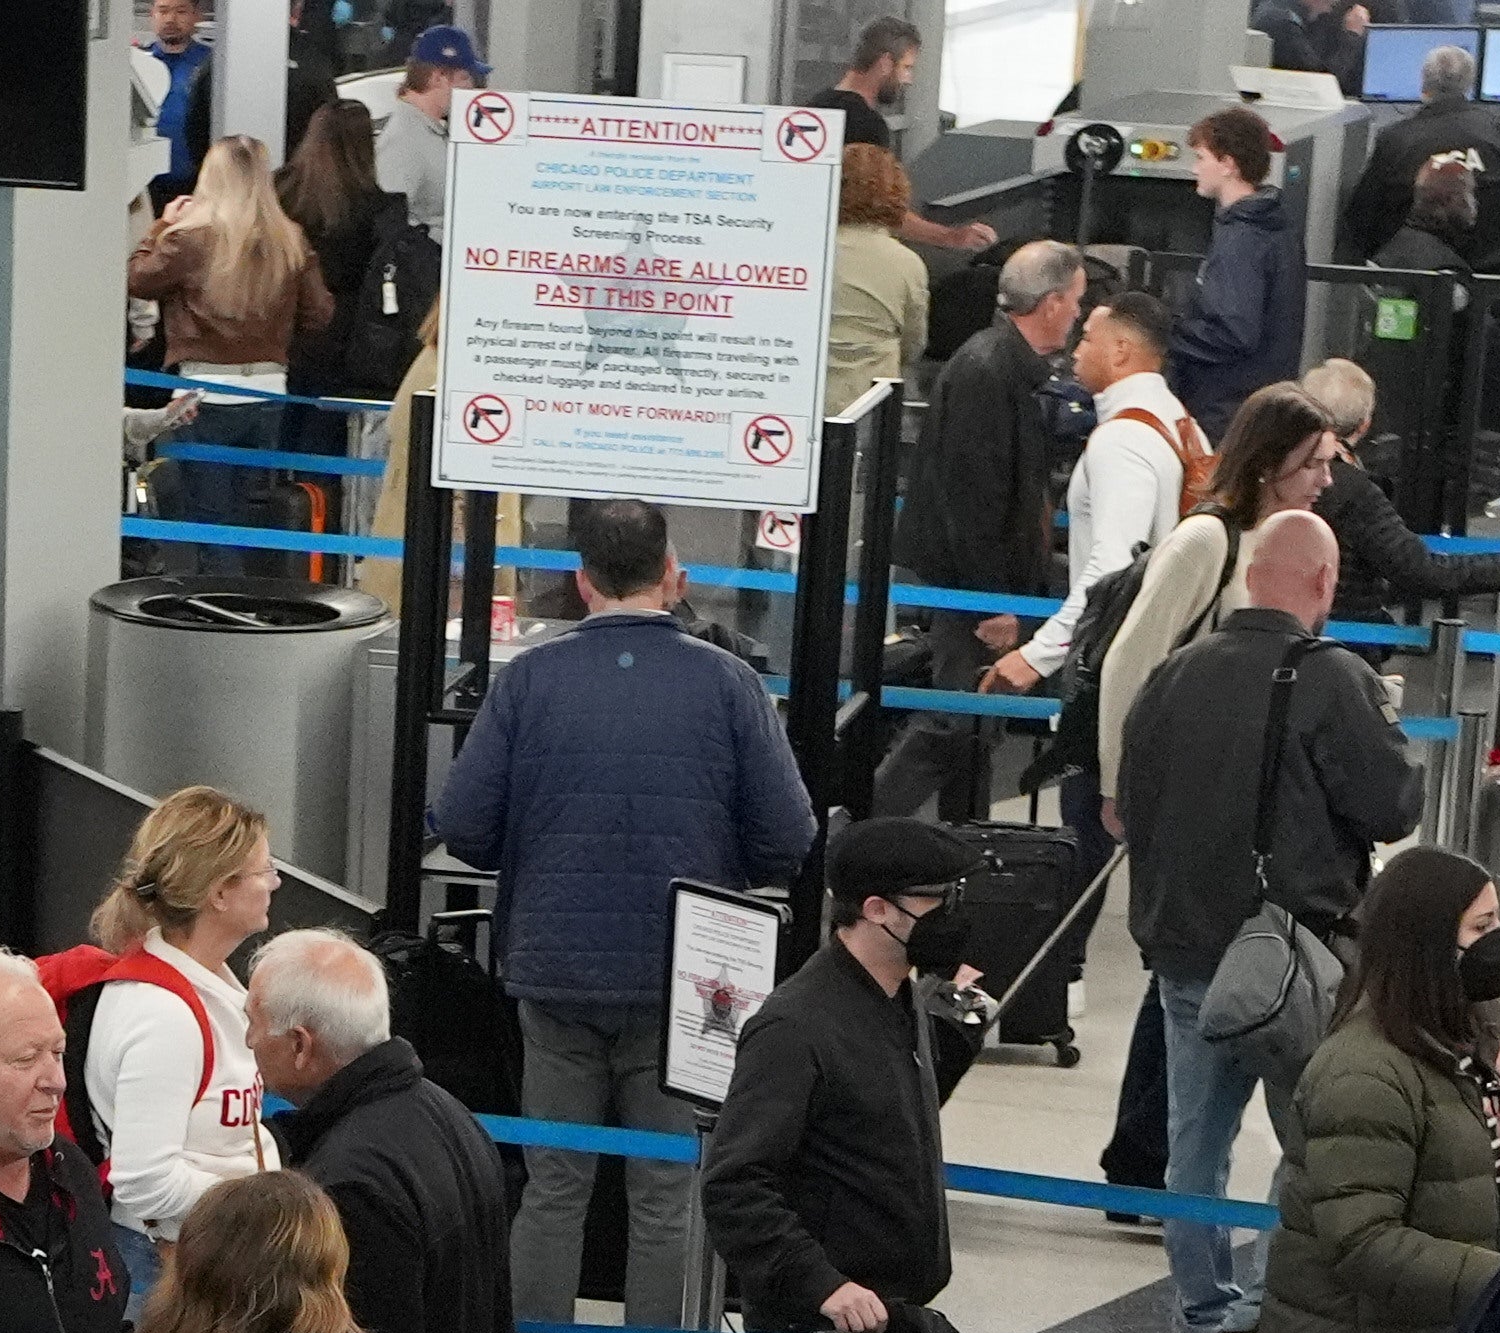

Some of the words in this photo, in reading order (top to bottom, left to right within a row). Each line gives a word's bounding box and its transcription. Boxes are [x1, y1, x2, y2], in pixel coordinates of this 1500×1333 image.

[535, 162, 599, 177] CHICAGO
[603, 165, 653, 180] POLICE
[658, 168, 754, 186] DEPARTMENT
[507, 203, 534, 216] You
[538, 207, 559, 217] are
[563, 208, 592, 219] now
[597, 208, 653, 224] entering
[657, 211, 679, 224] the
[683, 212, 712, 225] TSA
[716, 214, 774, 231] Security
[572, 226, 641, 242] Screening
[645, 230, 704, 245] Process.
[465, 247, 499, 268] NO
[507, 249, 627, 275] FIREARMS
[633, 257, 682, 278] ARE
[690, 261, 808, 286] ALLOWED
[535, 284, 596, 305] PAST
[603, 287, 654, 308] THIS
[663, 291, 734, 313] POINT
[525, 399, 547, 412] DO
[551, 401, 582, 414] NOT
[587, 403, 631, 417] MOVE
[90, 1247, 117, 1301] A
